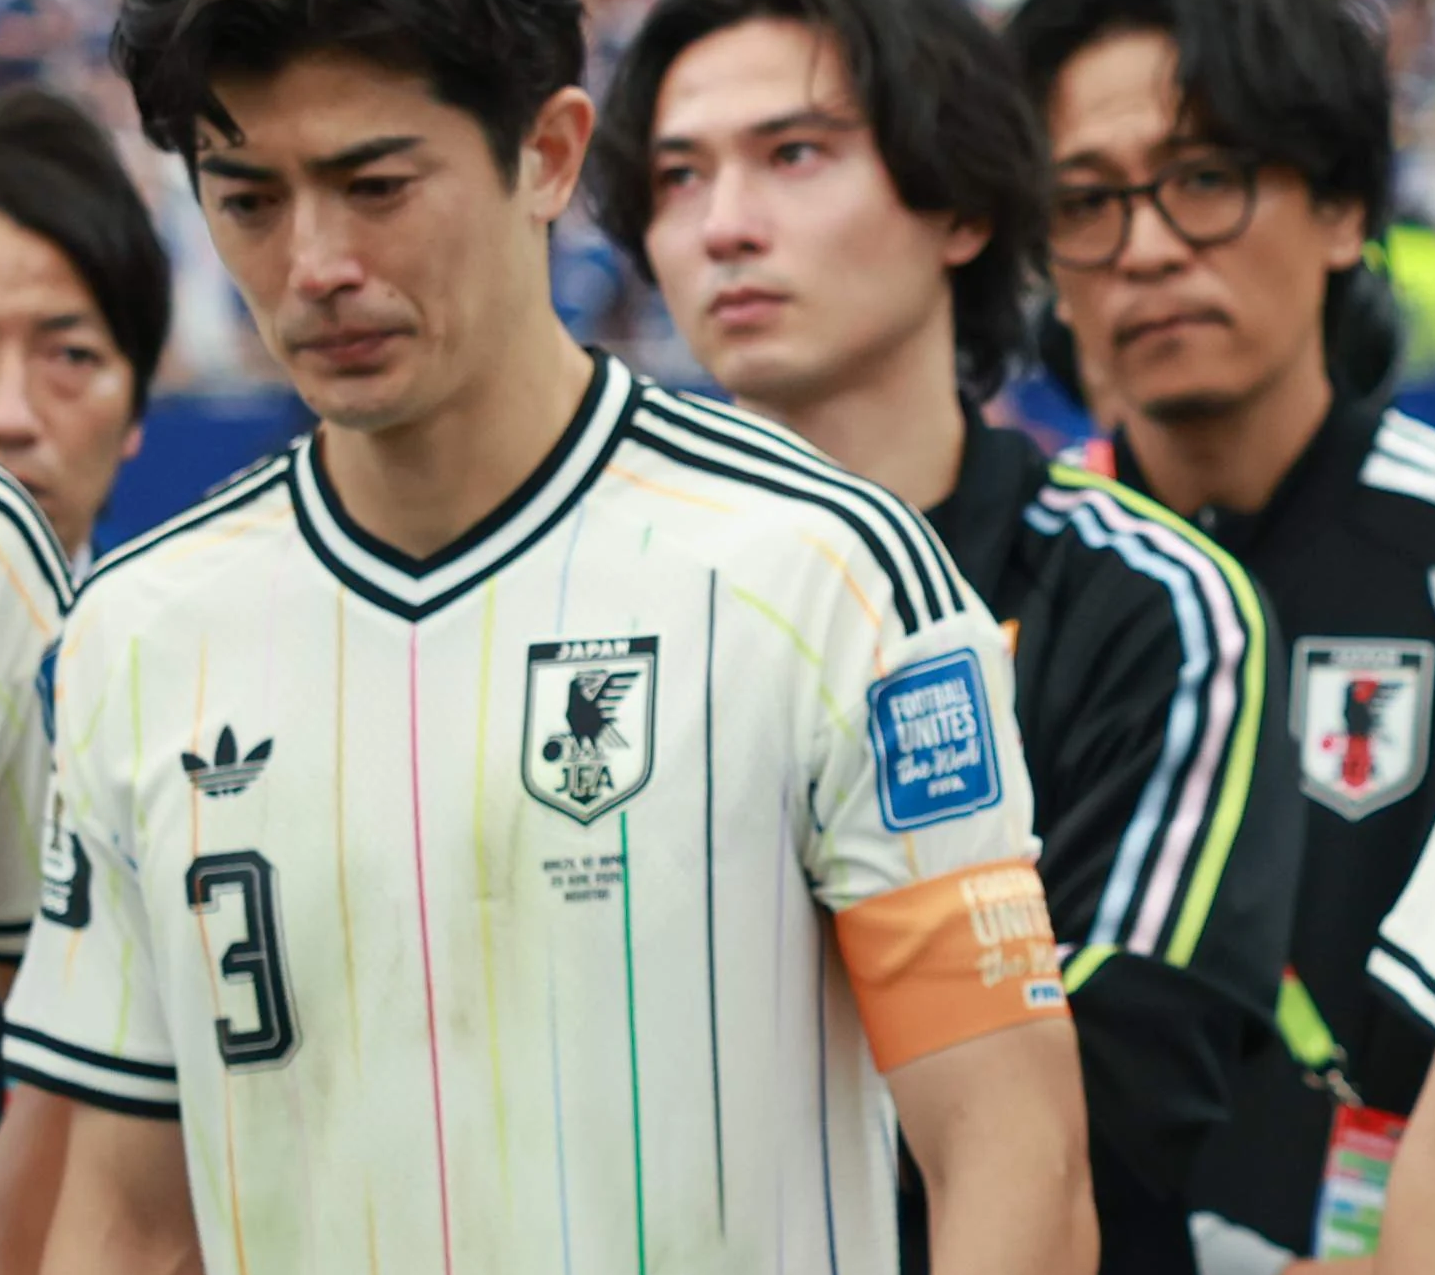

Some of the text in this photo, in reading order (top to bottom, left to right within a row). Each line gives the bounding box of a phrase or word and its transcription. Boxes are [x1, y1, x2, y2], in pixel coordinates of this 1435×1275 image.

[556, 639, 630, 661] JAPAN
[896, 704, 977, 754] UNITES
[185, 850, 300, 1071] 3
